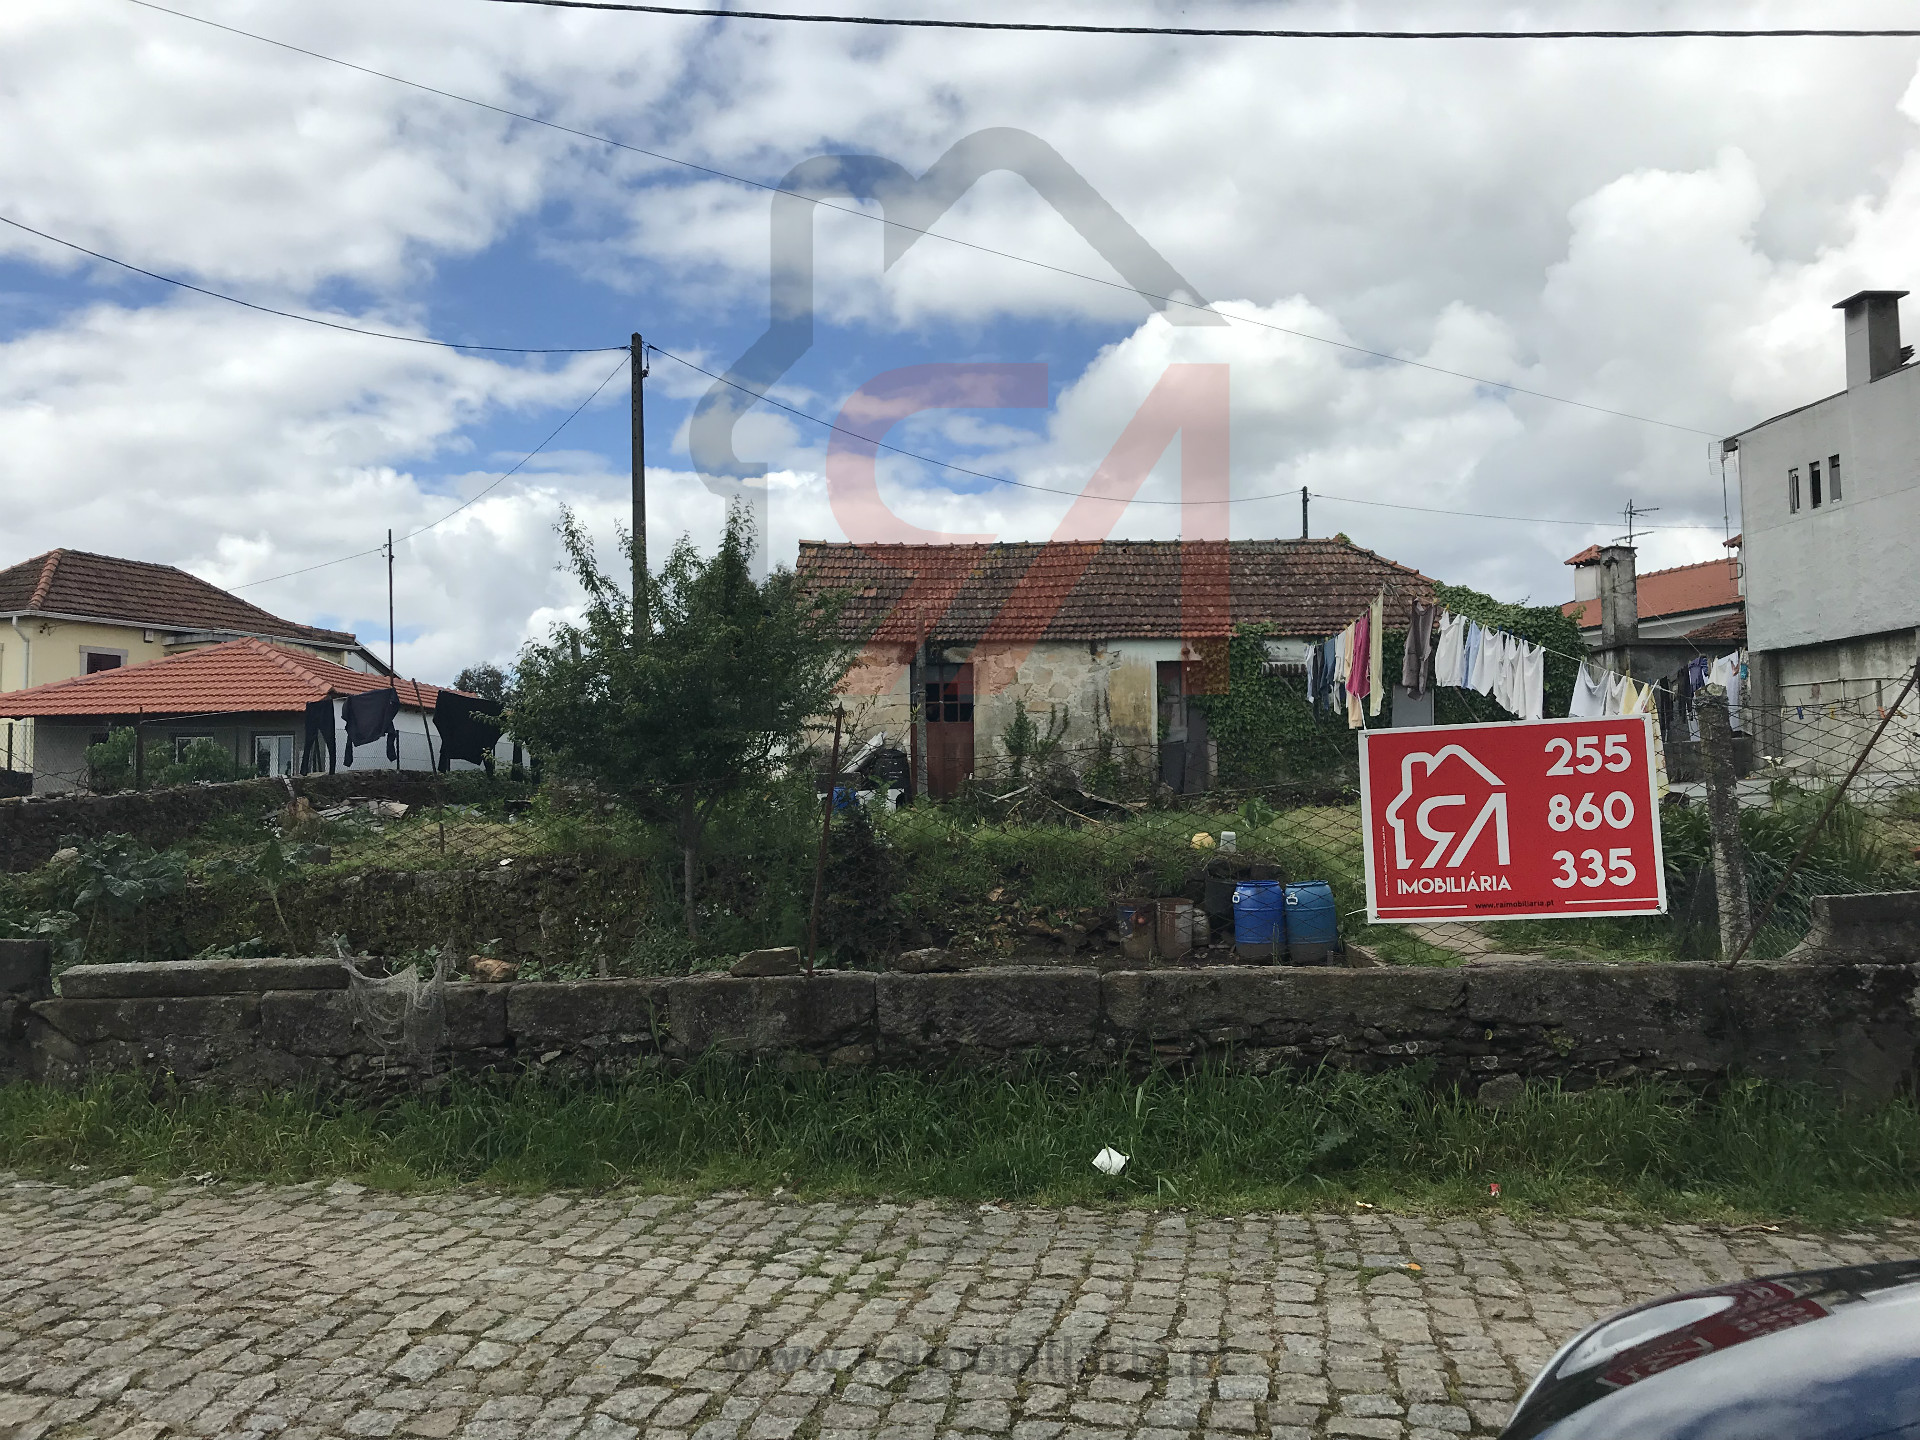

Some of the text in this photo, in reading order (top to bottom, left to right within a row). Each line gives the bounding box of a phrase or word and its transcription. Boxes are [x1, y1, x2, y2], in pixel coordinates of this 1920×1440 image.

[1544, 733, 1632, 777] 255
[1547, 791, 1635, 832] 860
[1397, 871, 1512, 895] IMOBILIÁRIA
[1551, 847, 1637, 889] 335
[1475, 899, 1554, 910] www.raimobiliaria.pt
